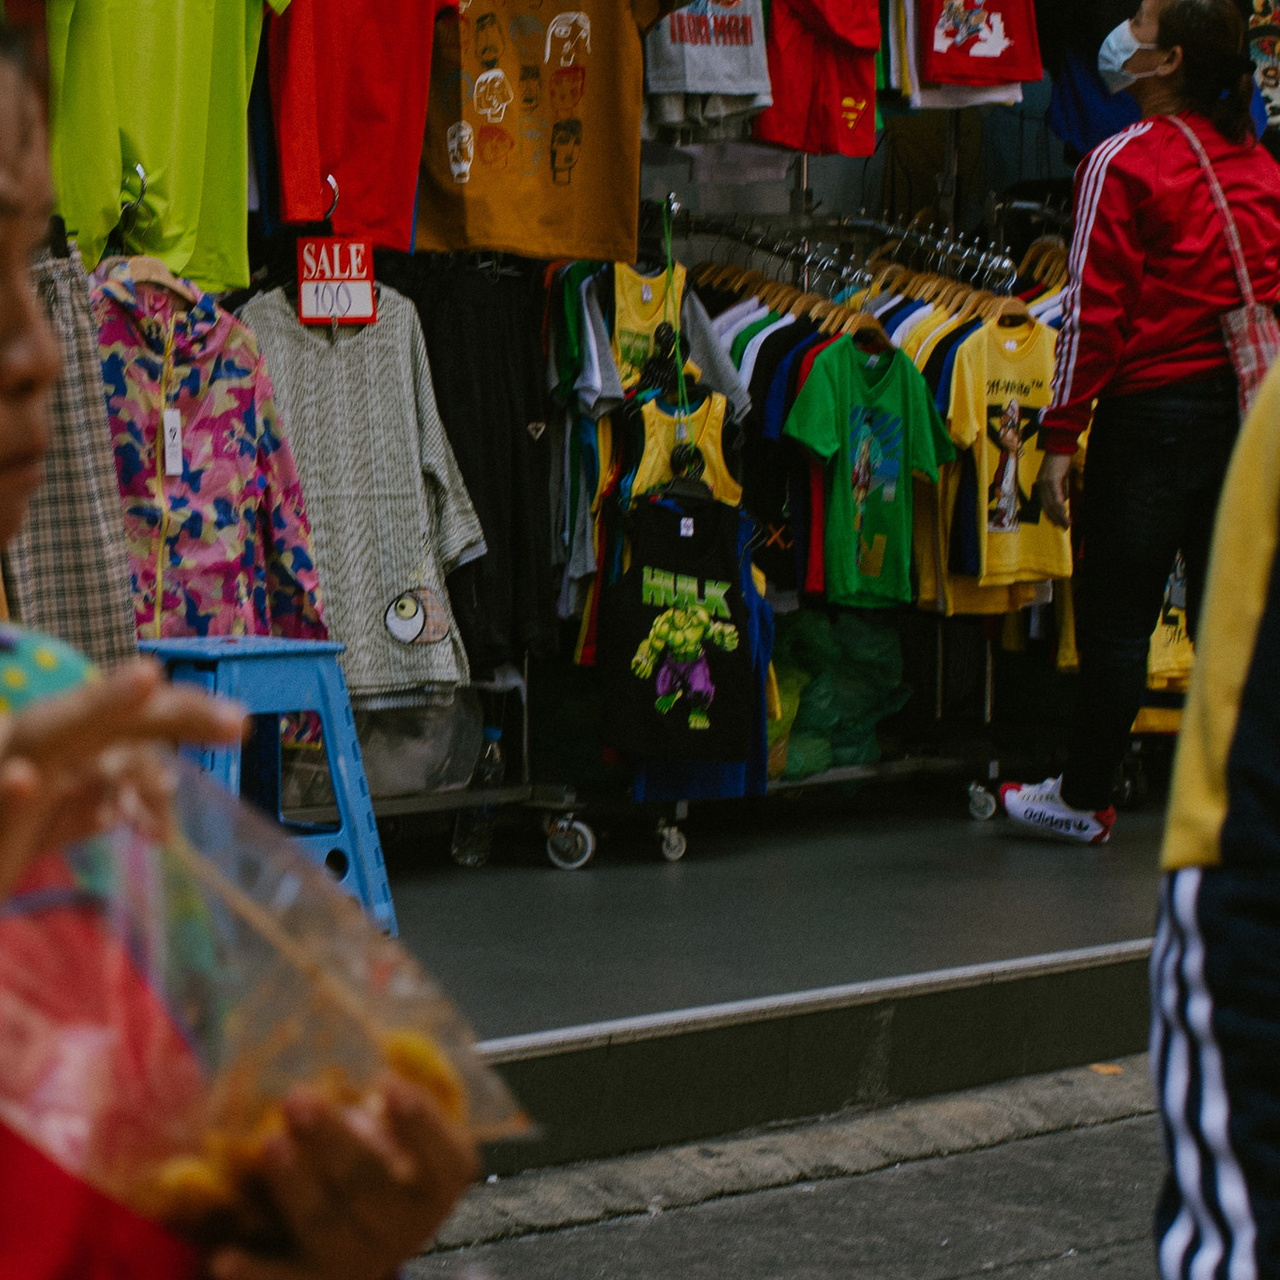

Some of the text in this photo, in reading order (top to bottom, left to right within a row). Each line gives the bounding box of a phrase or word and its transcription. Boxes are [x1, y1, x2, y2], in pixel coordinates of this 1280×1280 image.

[302, 242, 368, 280] SALE
[314, 280, 352, 317] 100
[642, 565, 732, 619] HULK
[1023, 806, 1073, 835] adidas
